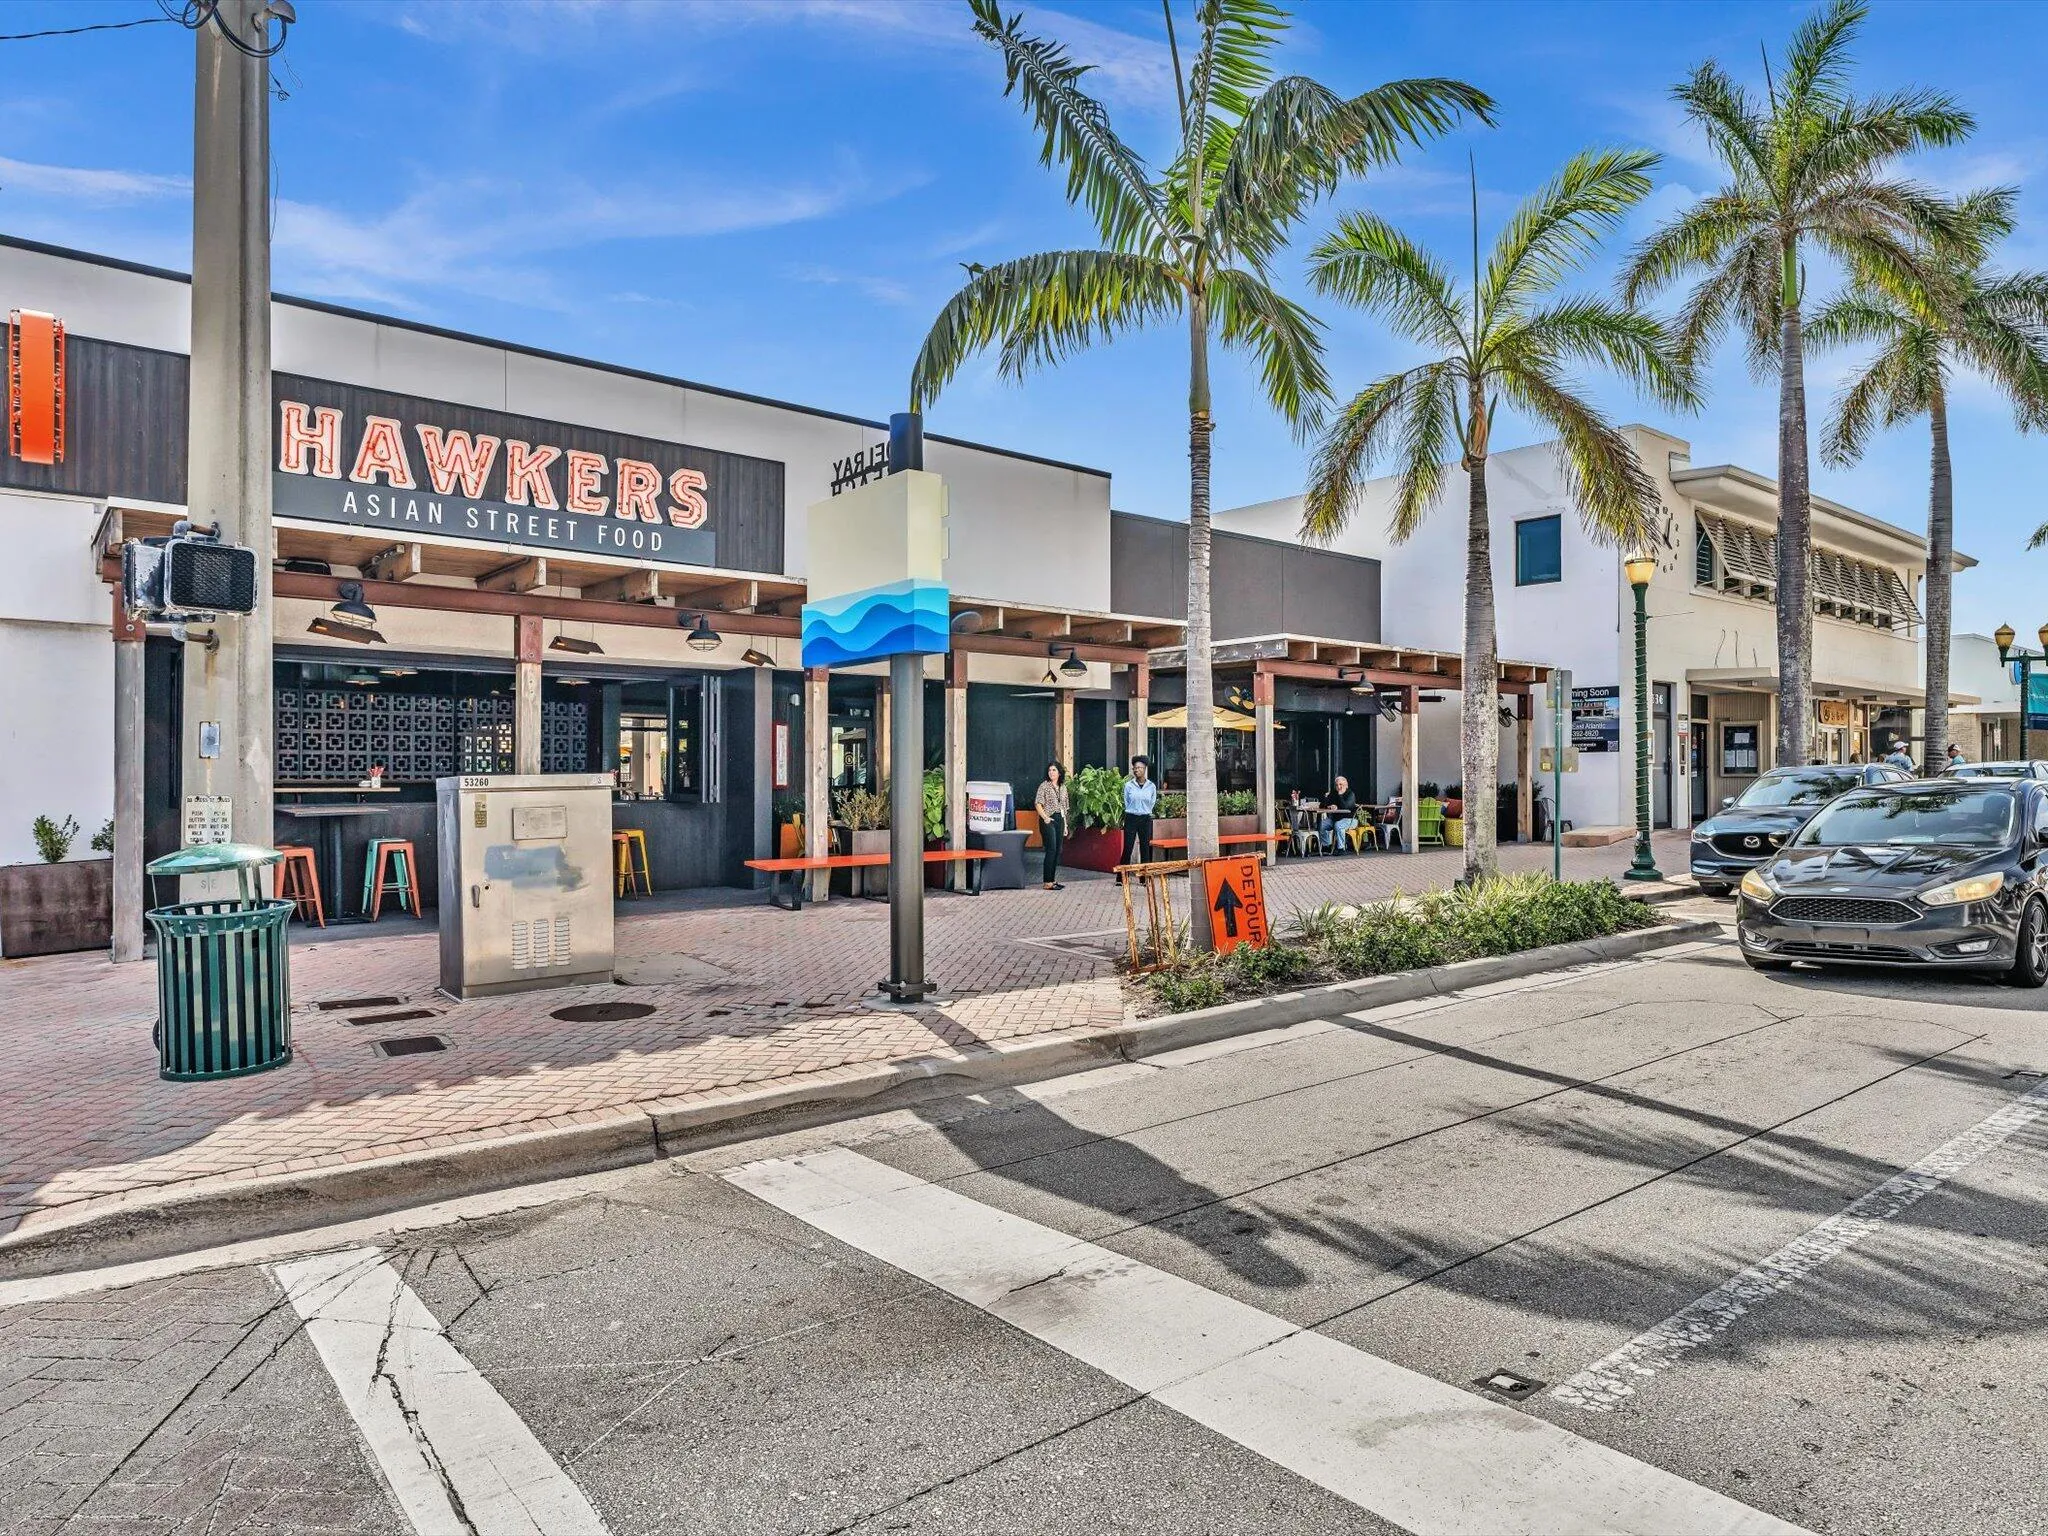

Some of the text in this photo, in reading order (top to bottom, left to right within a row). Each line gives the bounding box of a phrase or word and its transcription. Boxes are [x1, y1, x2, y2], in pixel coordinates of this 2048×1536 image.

[279, 400, 708, 529] HAWKERS
[343, 491, 663, 551] ASIAN STREET FOOD
[1589, 688, 1609, 696] Soon
[464, 778, 489, 787] 53260
[1241, 865, 1262, 943] DETOUR
